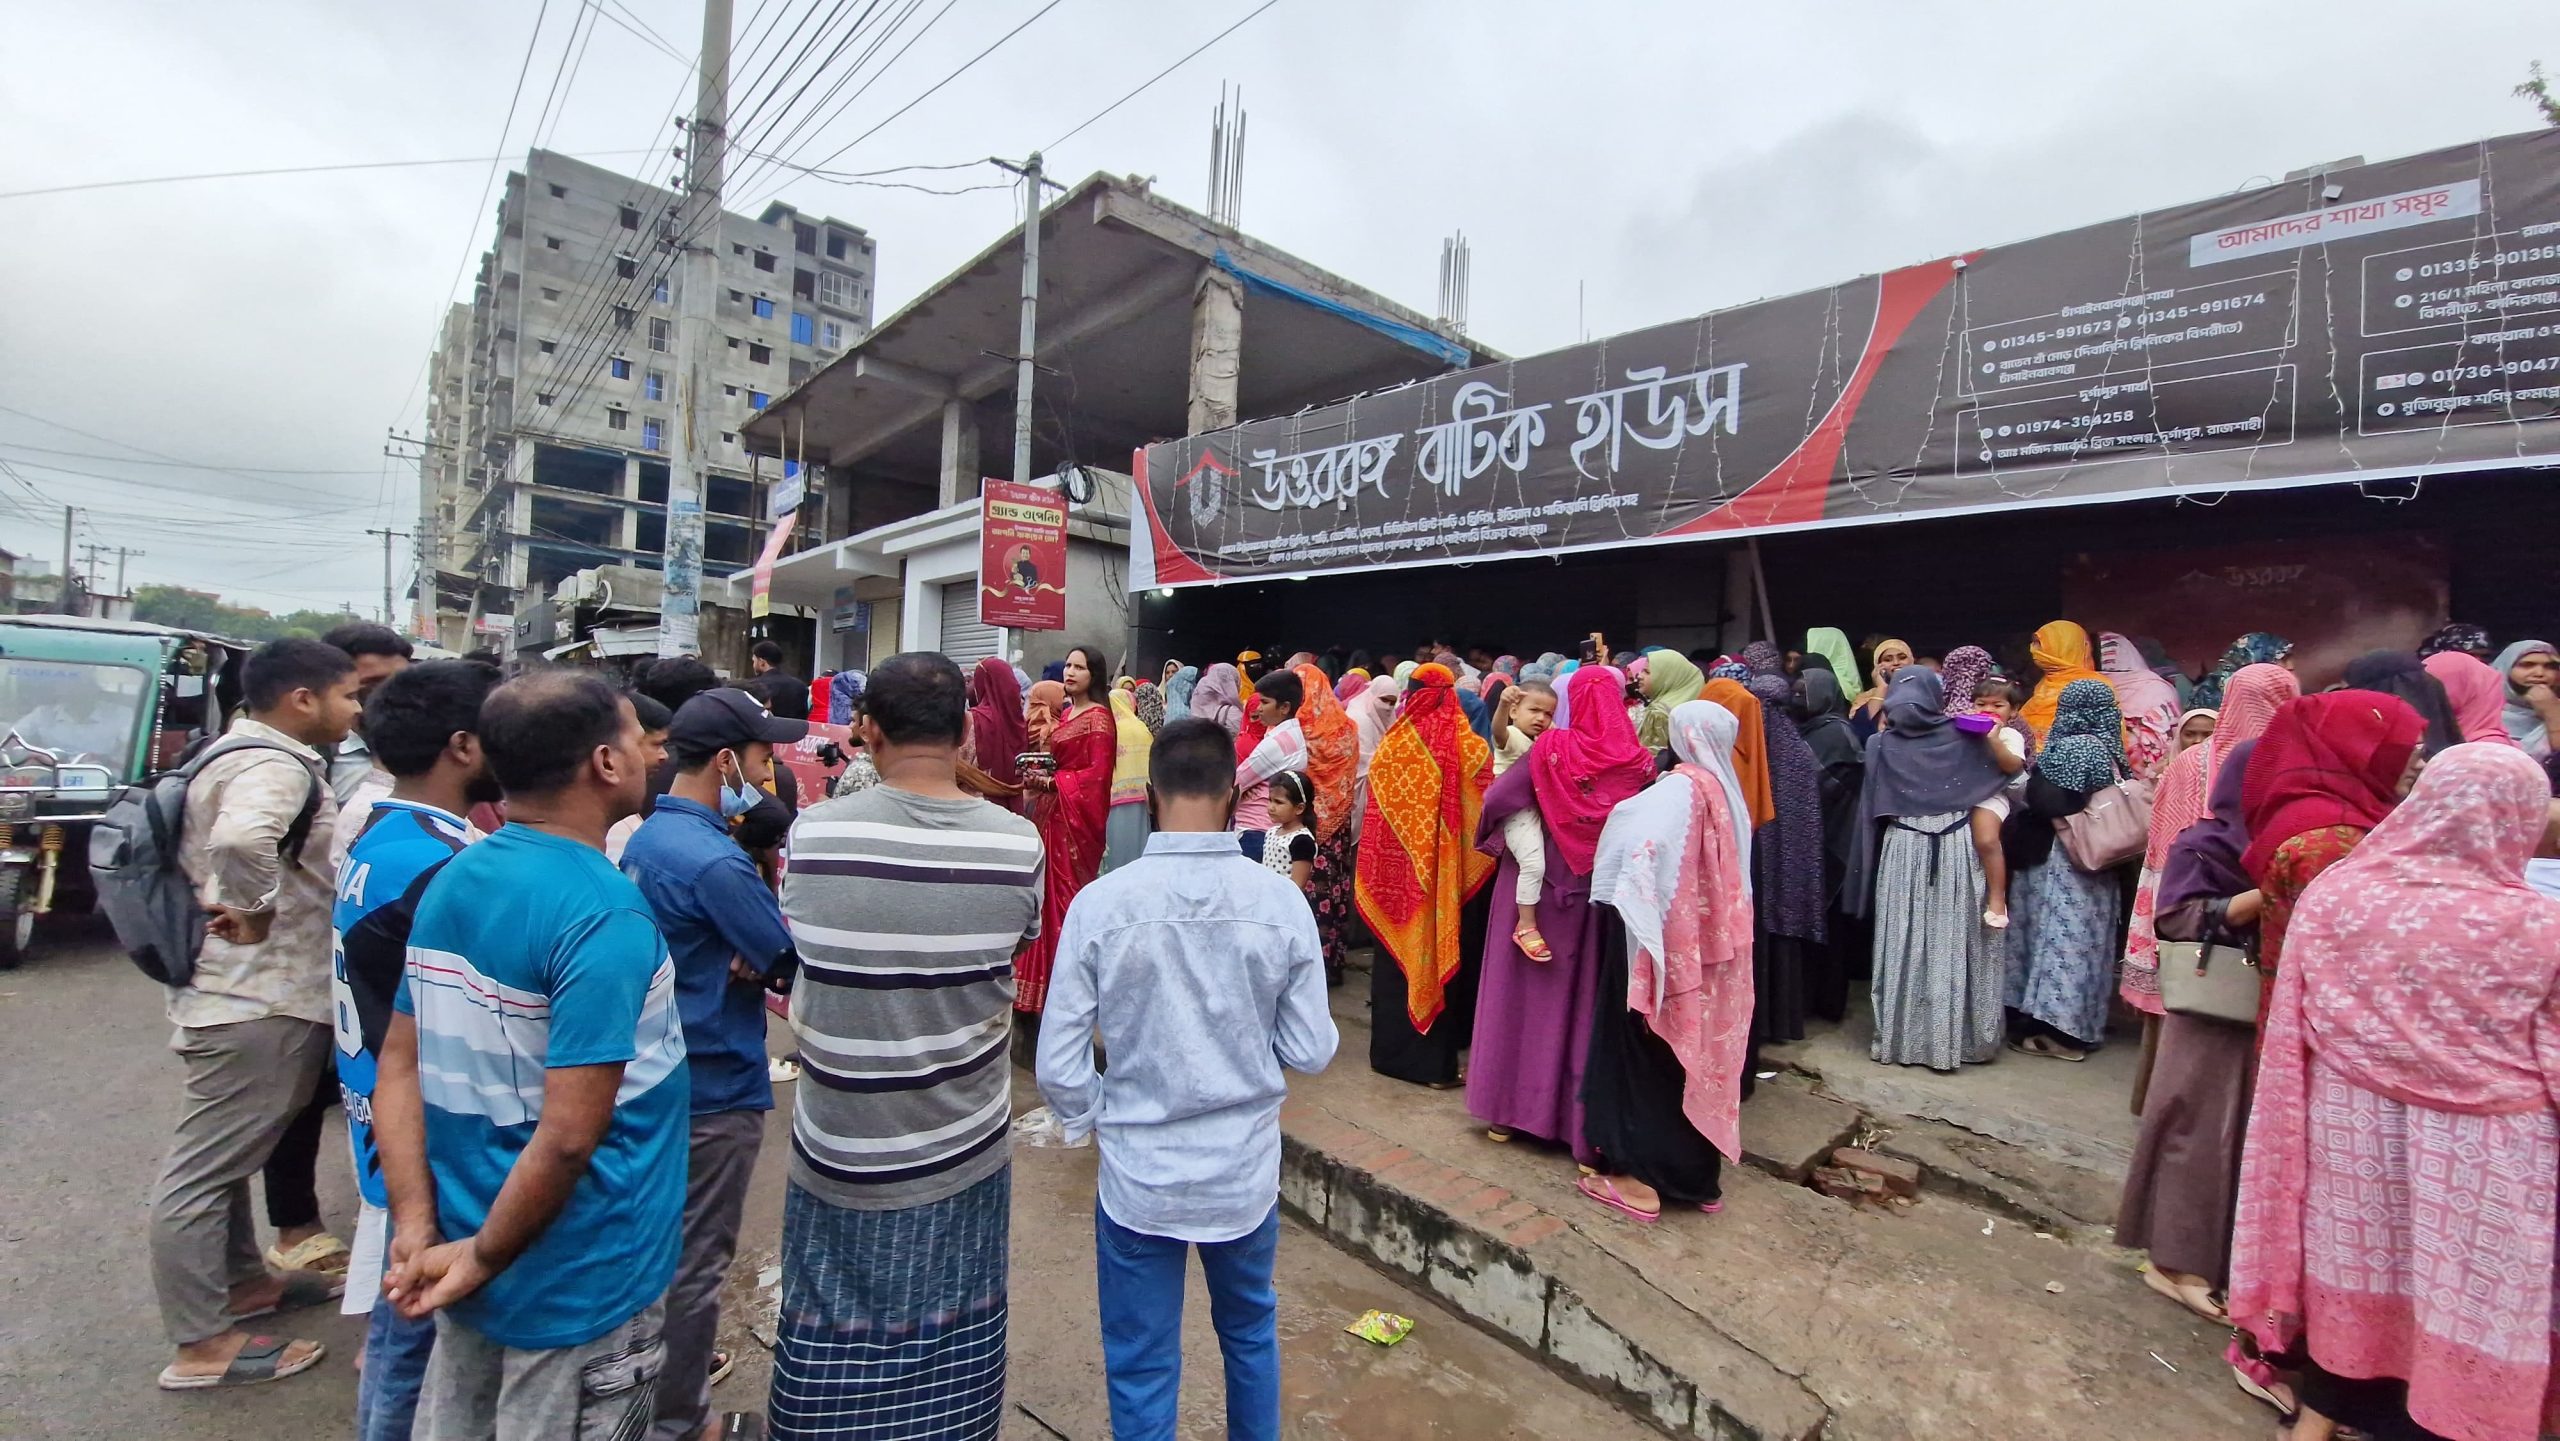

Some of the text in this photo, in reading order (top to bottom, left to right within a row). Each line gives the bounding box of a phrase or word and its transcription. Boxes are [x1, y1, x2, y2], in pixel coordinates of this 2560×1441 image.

[2217, 190, 2449, 249] আমাদের শাখা সমূহ
[2001, 292, 2265, 349] 01345-991673 01345-991674
[2420, 288, 2460, 304] 216/1
[1250, 363, 1749, 511] উত্তরবঙ্গ বাটিক হাউস
[2016, 410, 2134, 435] 01974-364258
